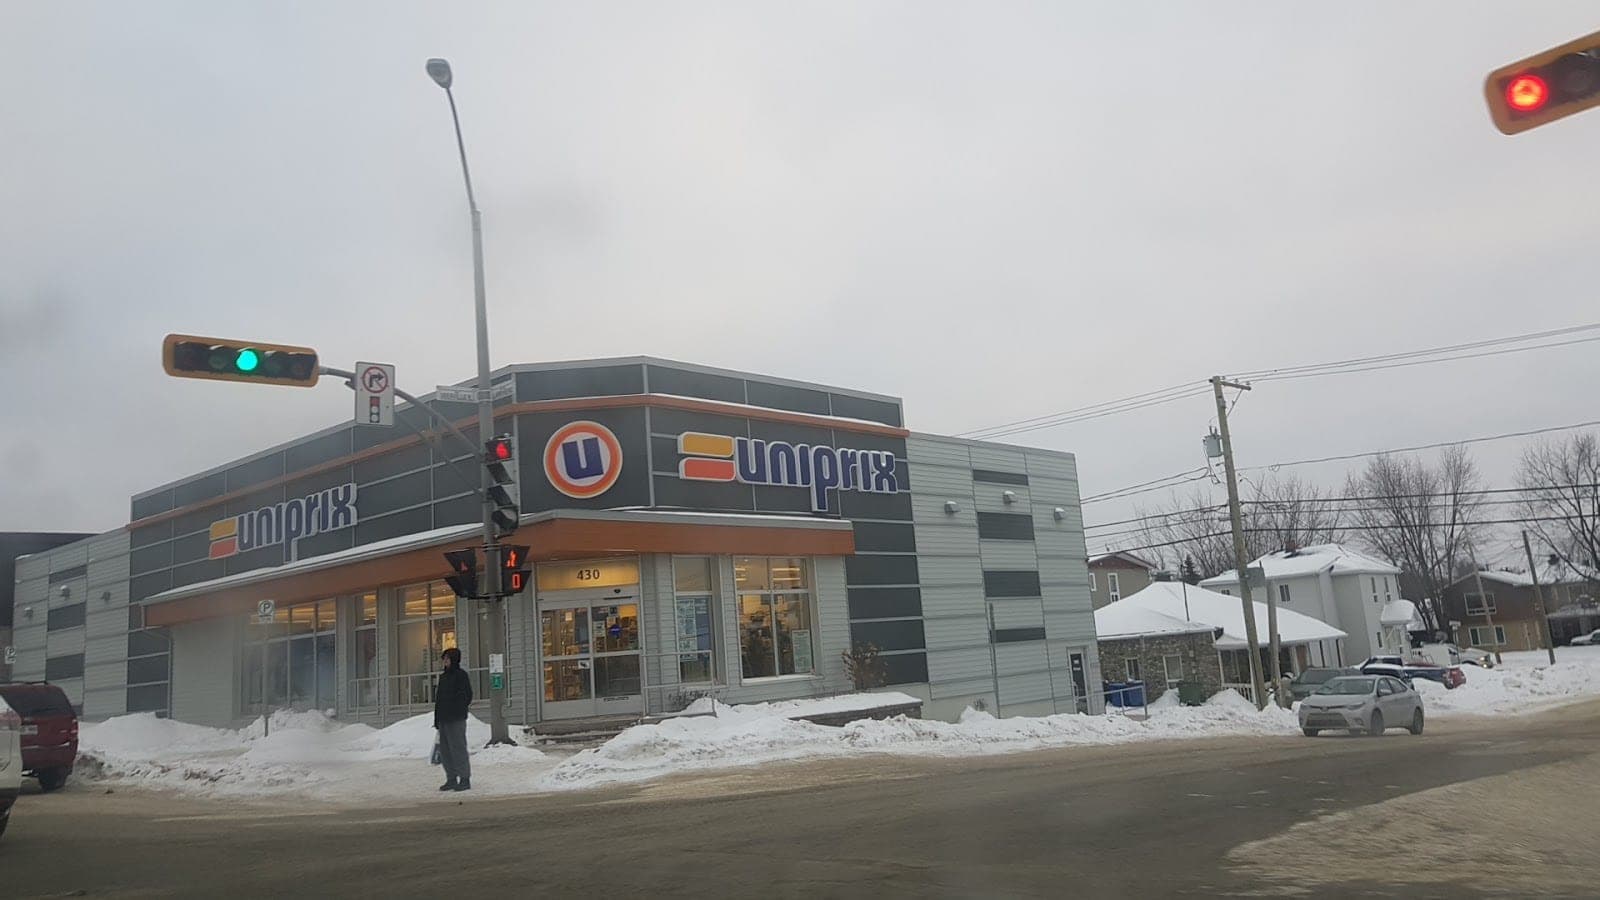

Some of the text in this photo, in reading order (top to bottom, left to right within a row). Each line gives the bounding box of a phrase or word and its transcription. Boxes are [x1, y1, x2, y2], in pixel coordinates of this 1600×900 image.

[736, 437, 898, 512] uniprix
[238, 483, 358, 564] uniprix
[576, 568, 601, 581] 430
